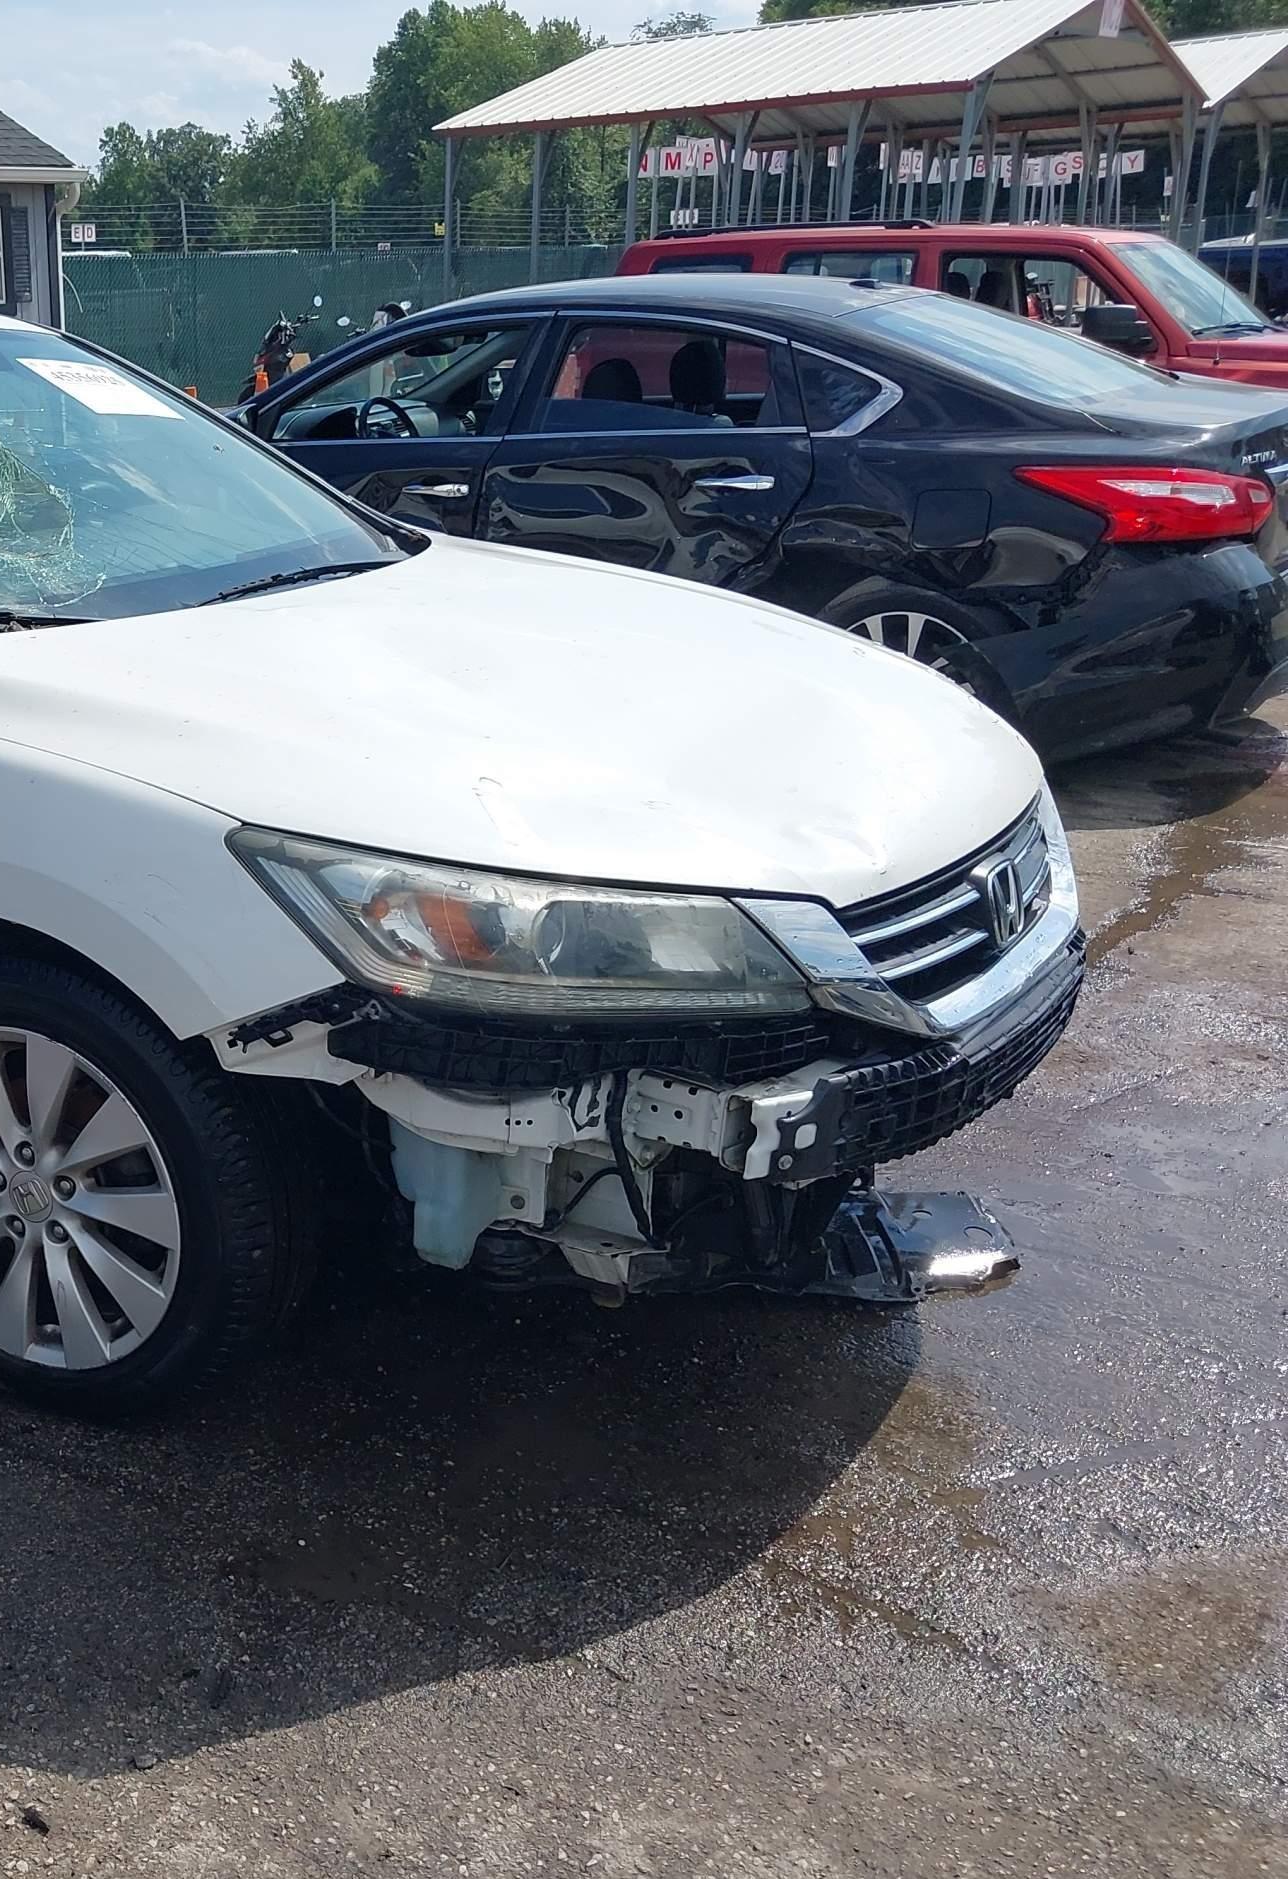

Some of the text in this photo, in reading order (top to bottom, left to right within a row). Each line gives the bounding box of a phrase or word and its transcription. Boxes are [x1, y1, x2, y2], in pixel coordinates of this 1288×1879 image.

[665, 151, 682, 171] M
[703, 152, 714, 171] P
[975, 159, 986, 173] B
[1054, 161, 1067, 176] G
[1072, 155, 1082, 170] S
[1127, 154, 1139, 169] Y
